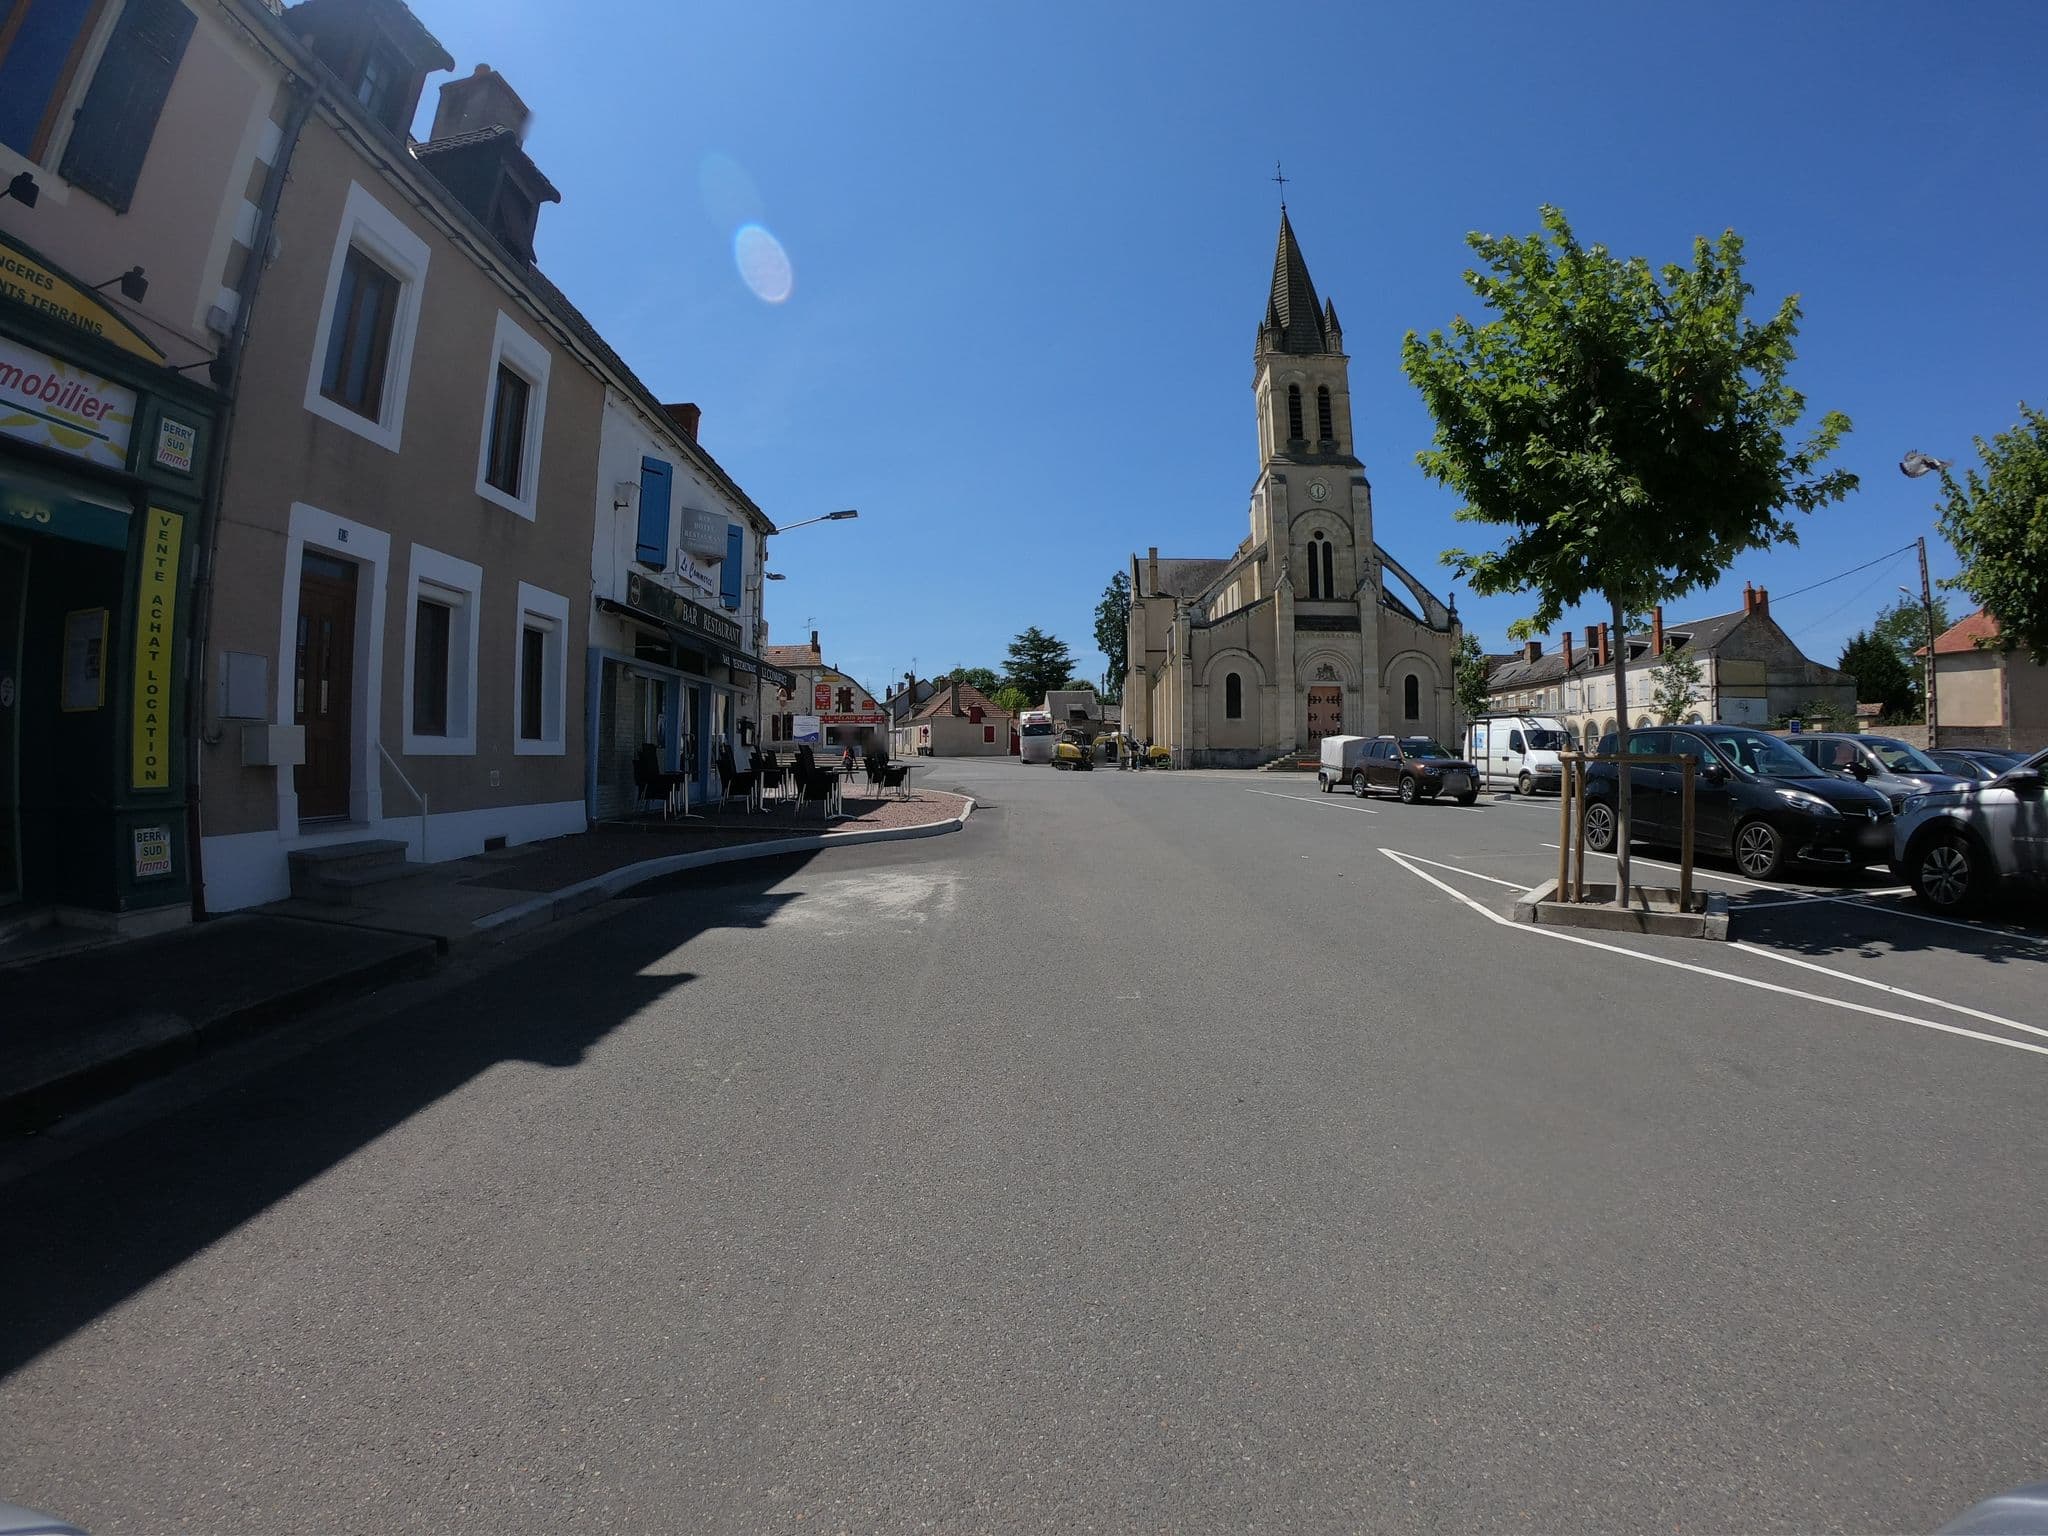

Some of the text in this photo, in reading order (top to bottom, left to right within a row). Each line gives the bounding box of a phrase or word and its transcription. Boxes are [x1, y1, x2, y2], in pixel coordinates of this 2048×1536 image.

[31, 293, 103, 335] TERRAINS
[163, 422, 194, 439] BERRY
[167, 438, 185, 451] SUD
[154, 515, 171, 582] VENTE
[148, 595, 164, 661] ACHAT
[682, 603, 741, 644] BAR RESTAURANT
[145, 669, 157, 781] LOCATION
[143, 846, 162, 856] SUD
